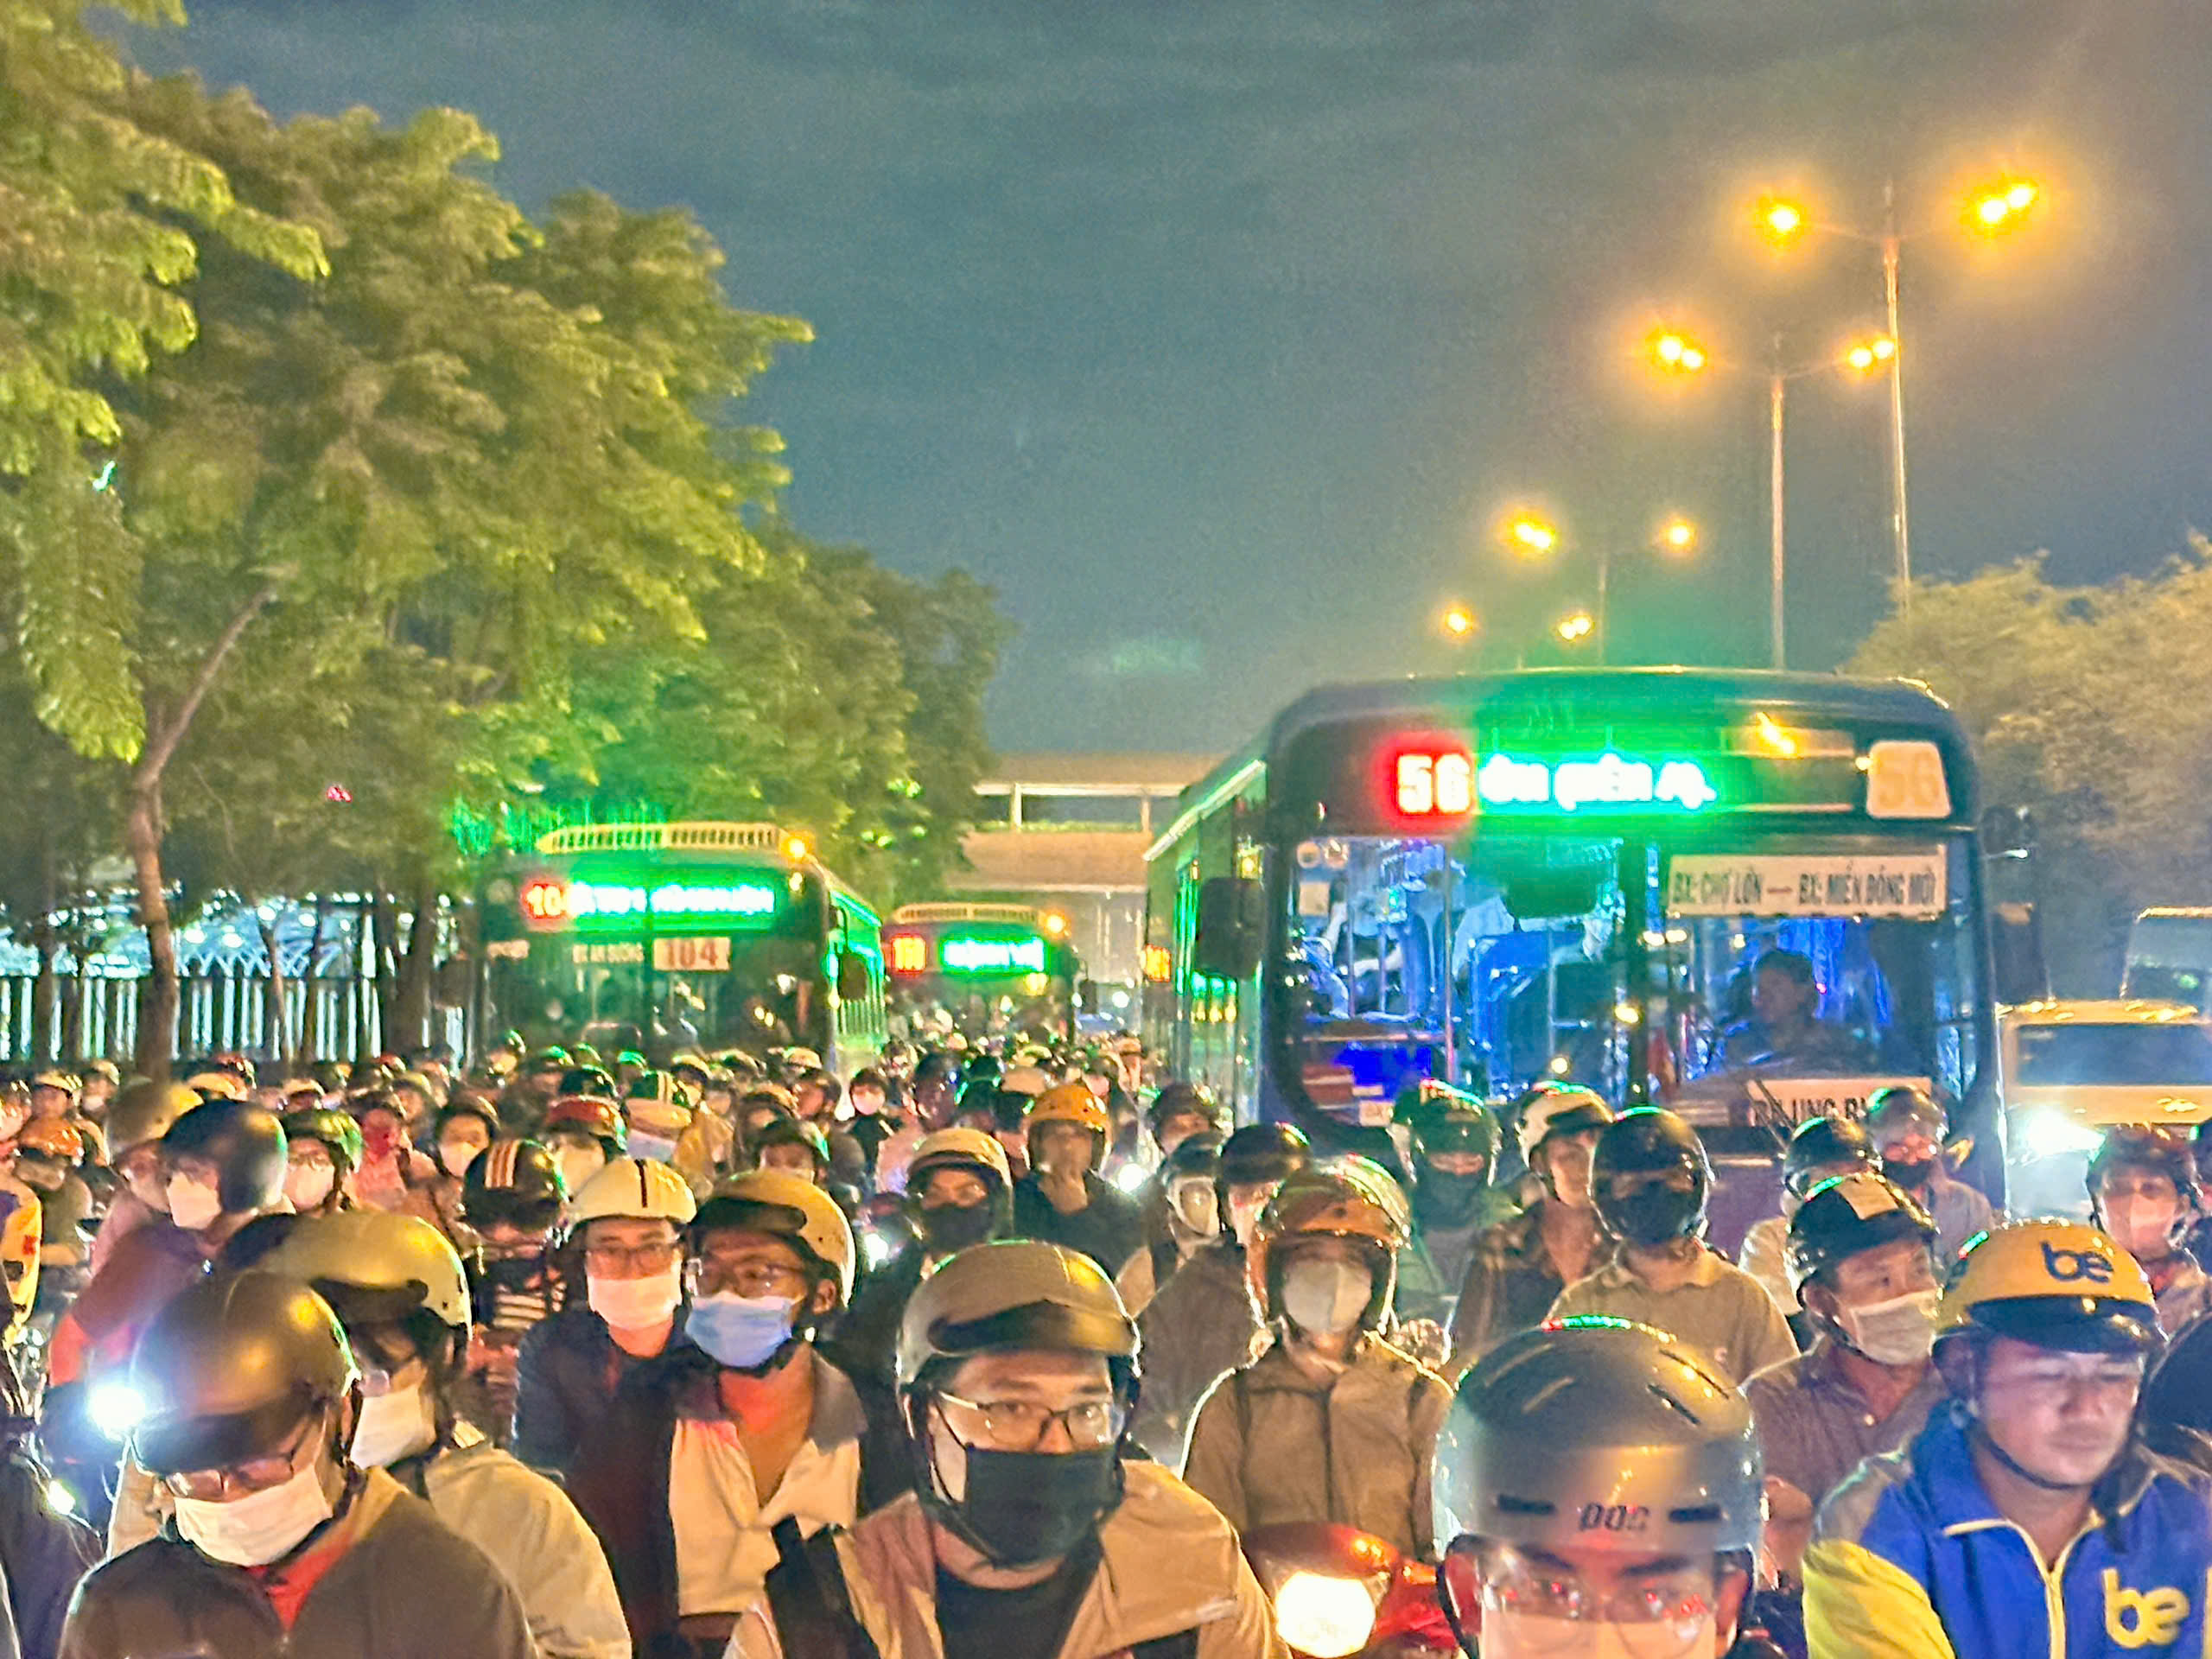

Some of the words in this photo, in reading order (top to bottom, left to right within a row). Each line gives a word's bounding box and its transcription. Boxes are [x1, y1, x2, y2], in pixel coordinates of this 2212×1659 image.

[1397, 753, 1471, 813] 56
[665, 939, 719, 969] 104
[2040, 1240, 2114, 1283] be
[2102, 1567, 2190, 1649] be
